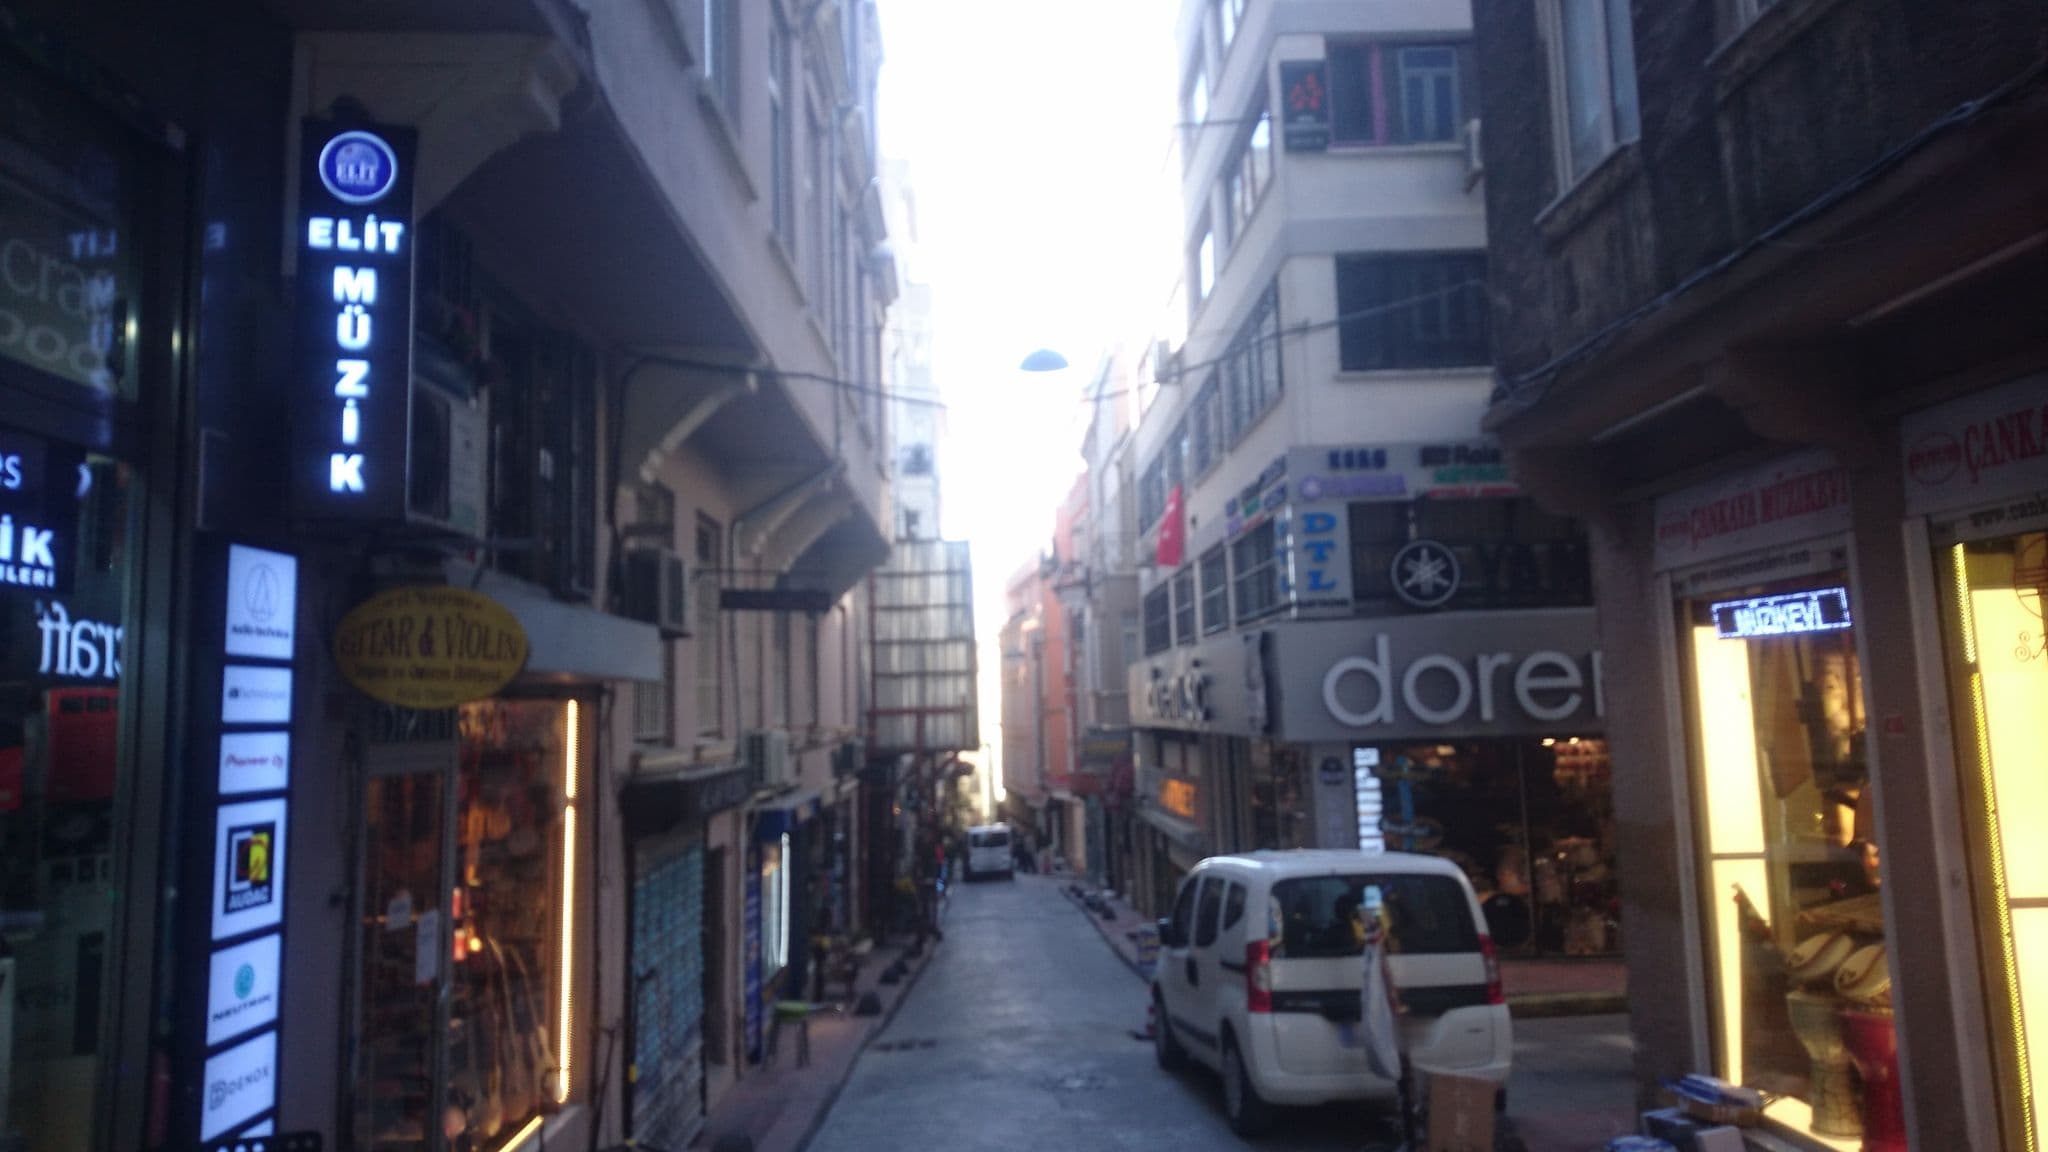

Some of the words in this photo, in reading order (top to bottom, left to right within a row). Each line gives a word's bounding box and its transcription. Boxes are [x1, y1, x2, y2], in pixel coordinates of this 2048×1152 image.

[308, 214, 404, 253] ELİT
[330, 266, 377, 493] MÜZİK
[418, 614, 436, 658] &
